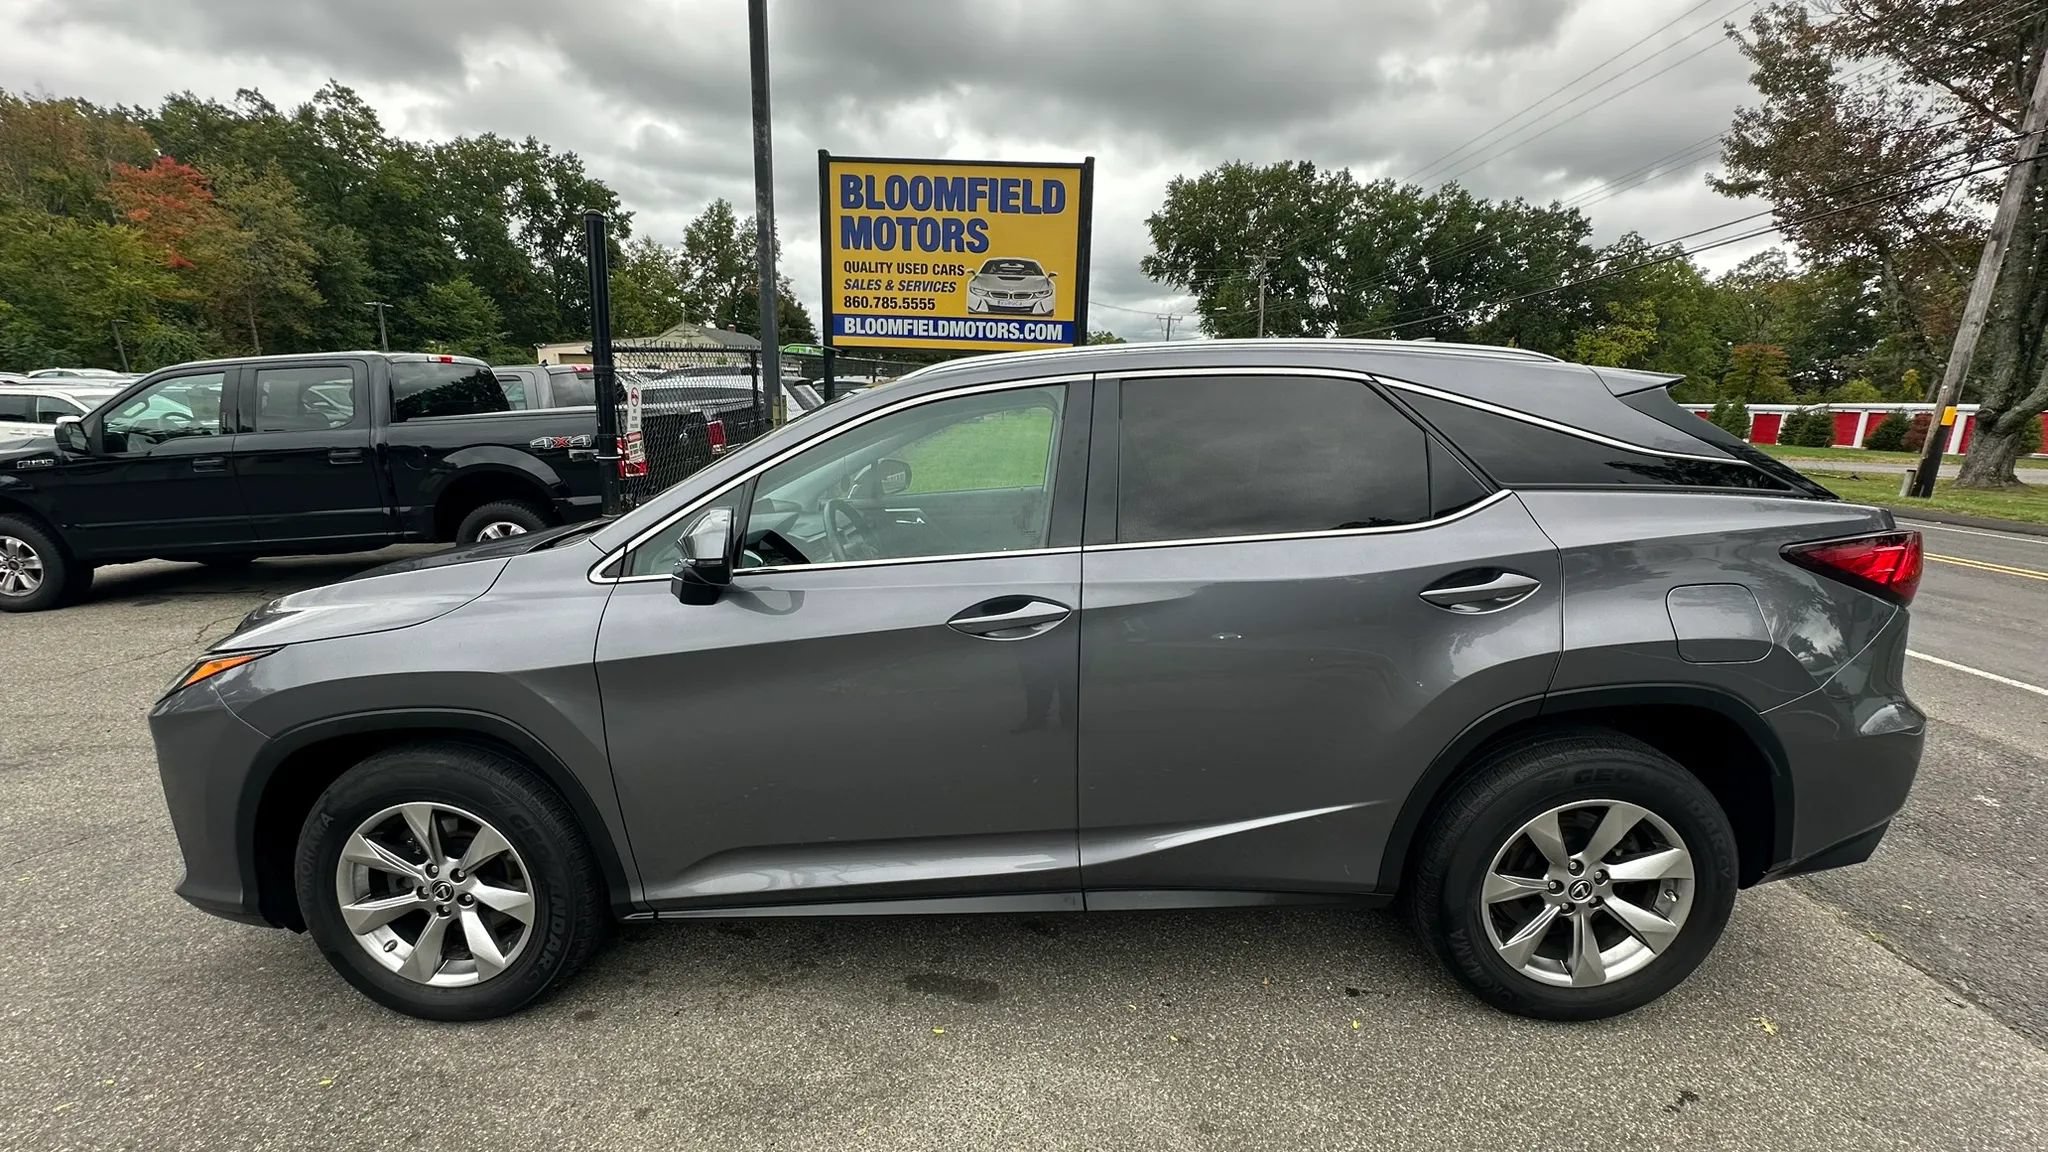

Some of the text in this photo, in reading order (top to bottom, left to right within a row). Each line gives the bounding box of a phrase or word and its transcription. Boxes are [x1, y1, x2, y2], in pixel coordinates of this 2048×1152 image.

[840, 174, 1066, 214] BLOOMFIELD
[840, 215, 989, 253] MOTORS
[843, 260, 965, 276] QUALITY USED CARS
[843, 278, 957, 293] SALES & SERVICES
[843, 295, 936, 310] 860.785.5555
[844, 317, 1063, 341] BLOOMFIELDMOTORS.COM
[508, 813, 568, 971] GEOANDAR
